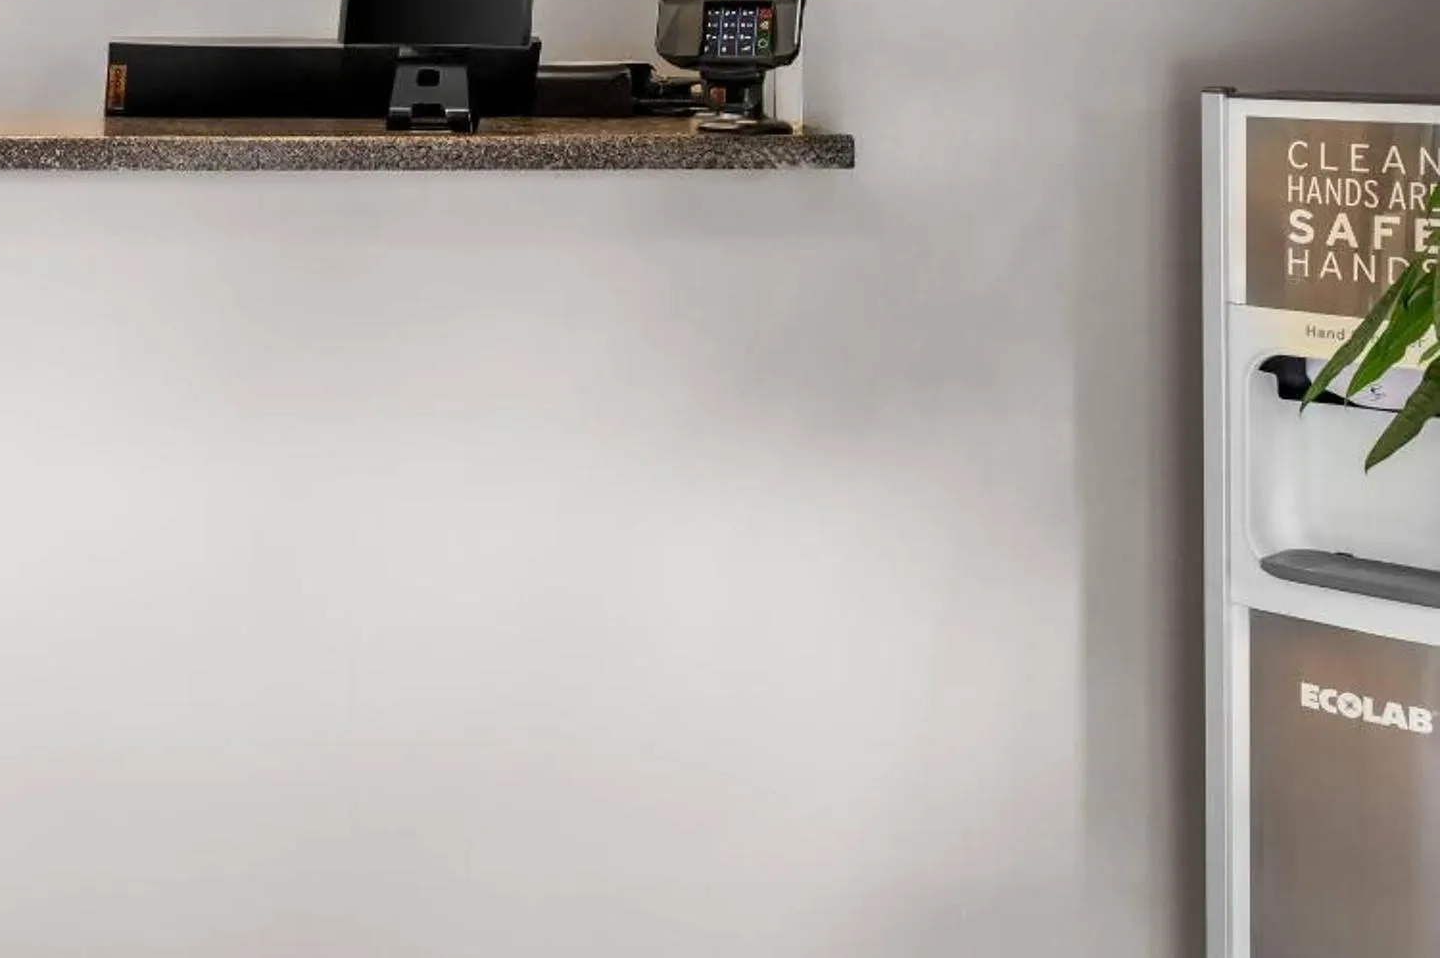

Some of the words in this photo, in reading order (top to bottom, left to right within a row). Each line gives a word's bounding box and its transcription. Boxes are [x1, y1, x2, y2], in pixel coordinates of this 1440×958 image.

[1287, 140, 1440, 176] CLEAN
[1287, 174, 1380, 209] HANDS
[1288, 208, 1440, 254] SAFE
[1305, 325, 1346, 341] Hand
[1300, 681, 1434, 734] ECOLAB
